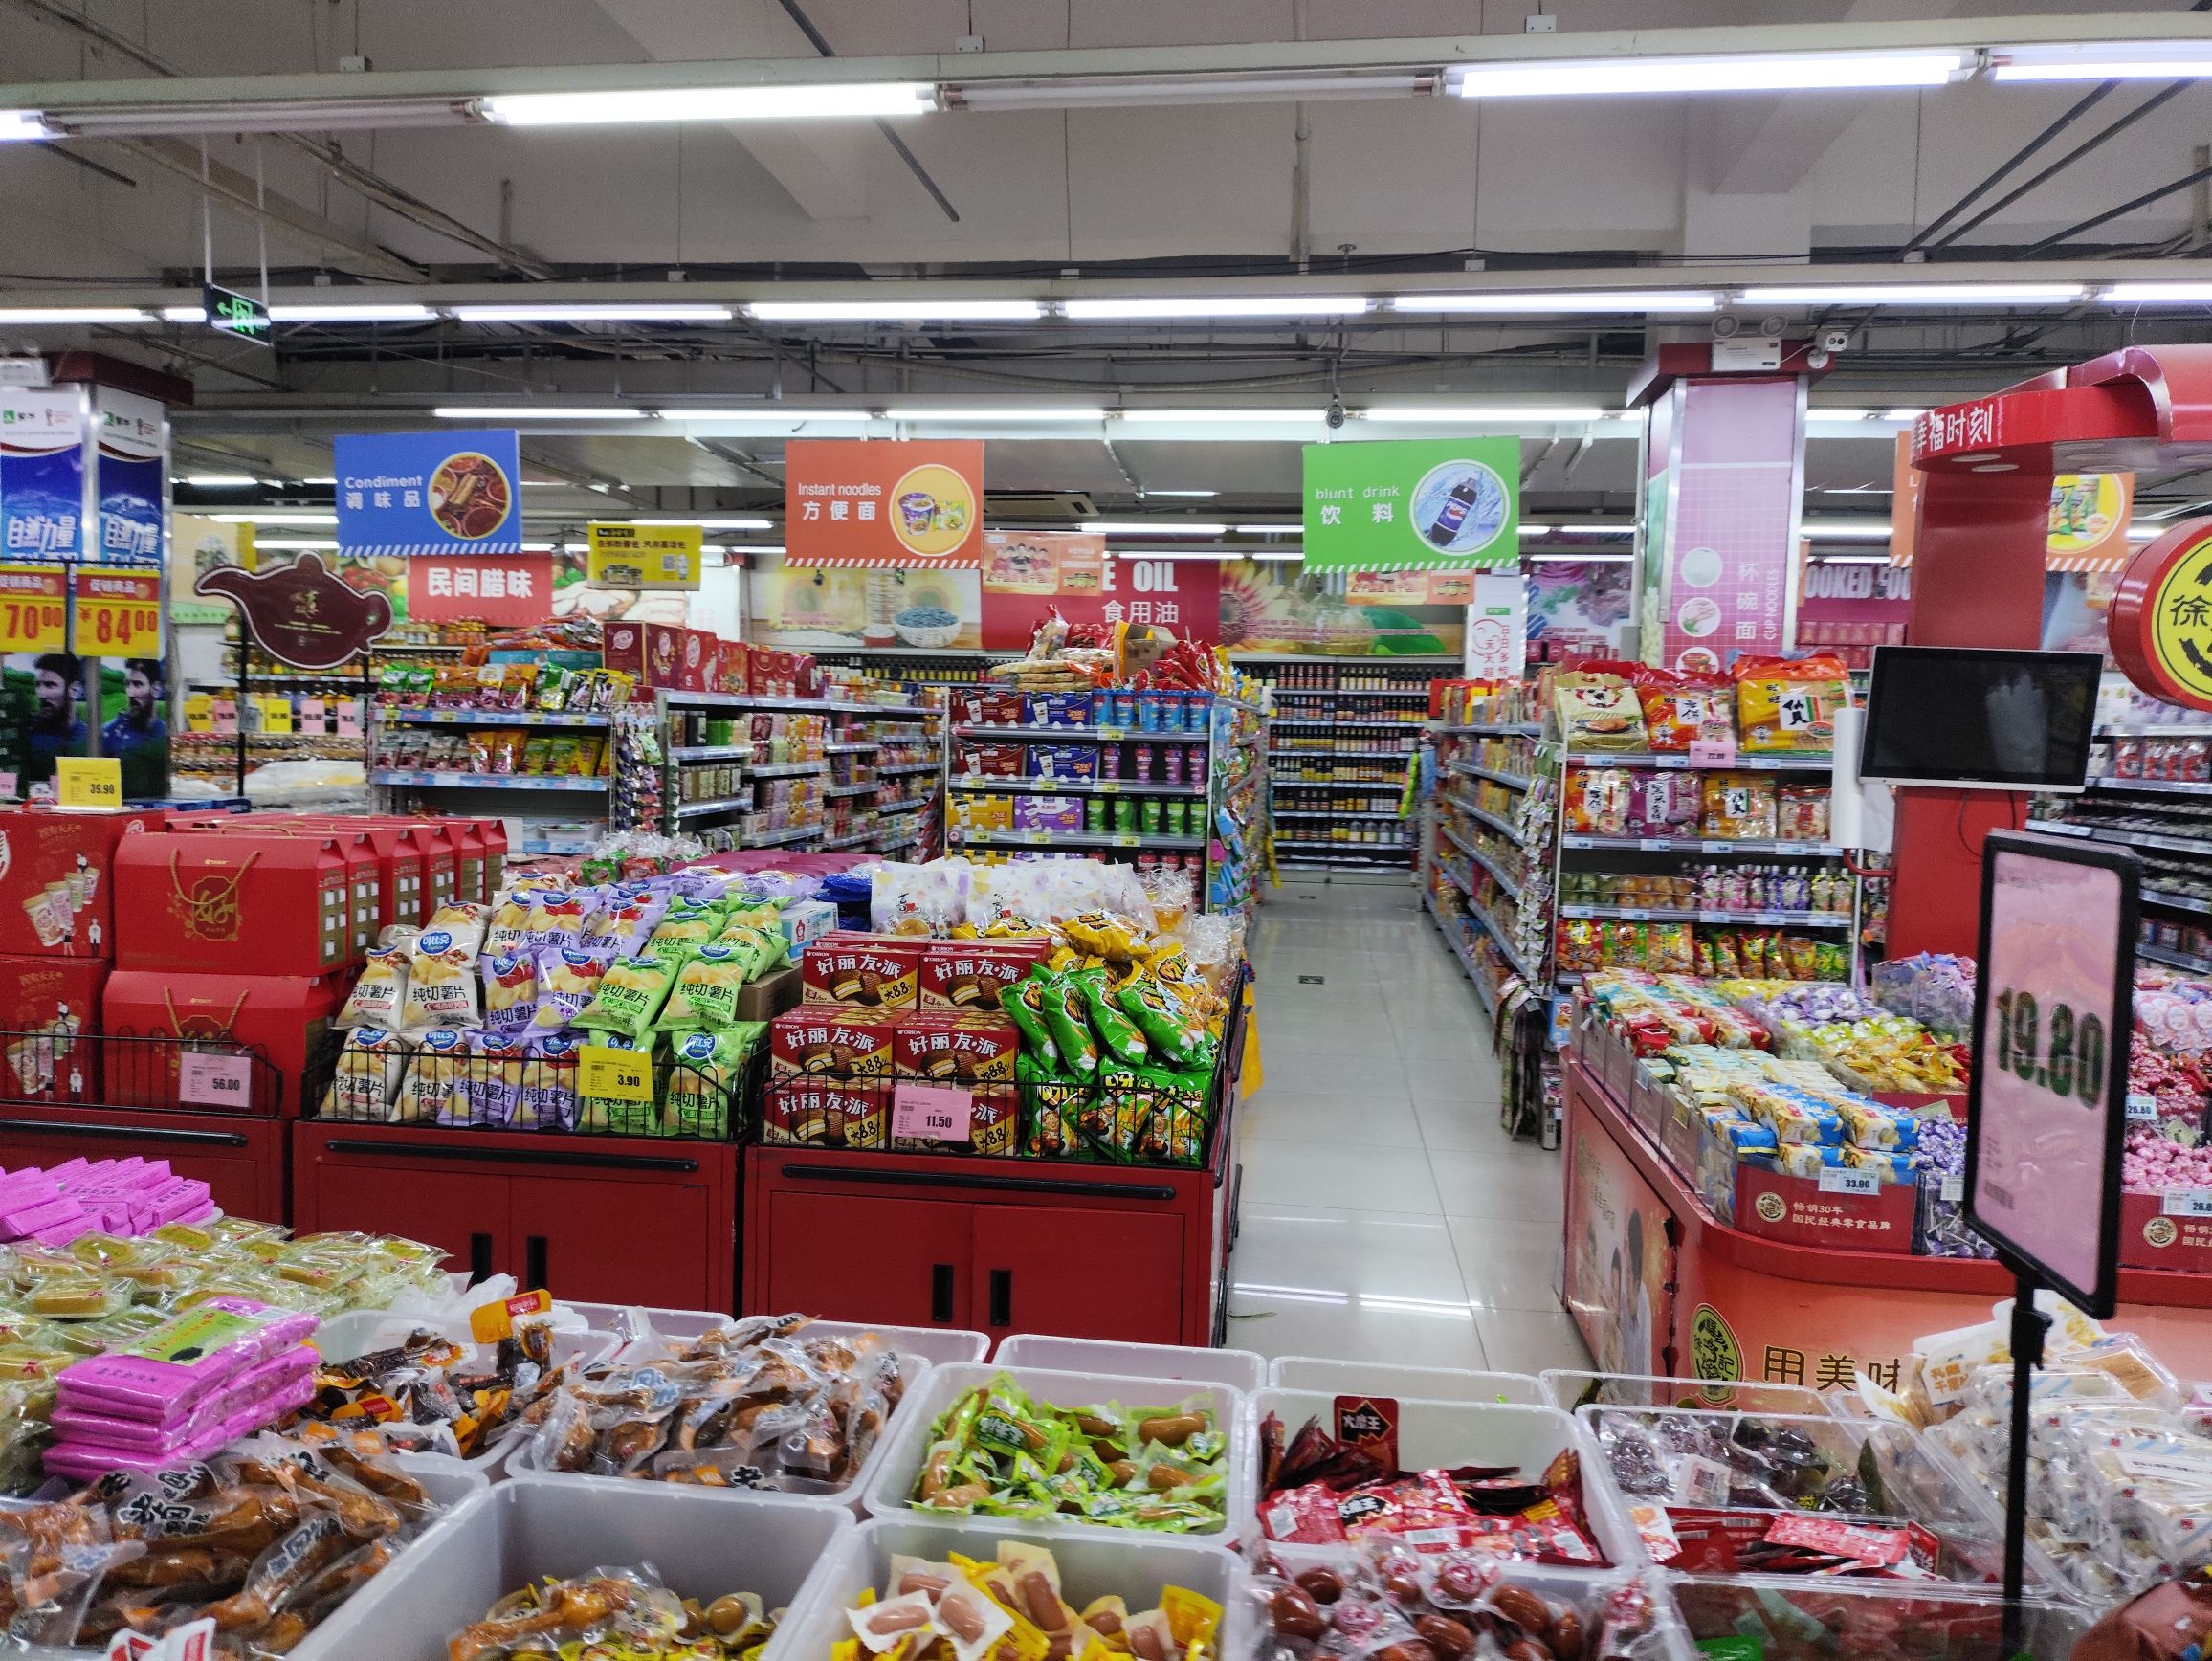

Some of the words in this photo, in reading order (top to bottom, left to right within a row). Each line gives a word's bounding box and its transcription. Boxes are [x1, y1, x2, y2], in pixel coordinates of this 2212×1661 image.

[344, 475, 423, 490] Condiment
[798, 482, 835, 497] Instant
[838, 482, 882, 497] noodles
[345, 490, 422, 510] 调味品
[1316, 488, 1355, 500] blunt
[1362, 486, 1401, 498] drink
[802, 500, 877, 521] 方便面
[1320, 502, 1394, 526] 饮料
[427, 566, 533, 599] 民间腊味
[1132, 560, 1180, 593] OIL
[1735, 561, 1759, 641] 杯碗面
[1764, 568, 1780, 618] NOODLES
[1101, 599, 1180, 624] 食用油
[2170, 594, 2212, 627] 徐
[1762, 622, 1778, 641] CUP
[90, 784, 115, 795] 39.90
[412, 985, 468, 1002] 纯切薯片
[599, 983, 651, 1007] 纯切薯片
[680, 983, 735, 1004] 纯切薯片
[212, 1077, 241, 1091] 56.00
[617, 1074, 641, 1087] 3.90
[2128, 1104, 2152, 1115] 26.80
[925, 1115, 953, 1129] 11.50
[1845, 1179, 1870, 1189] 33.90
